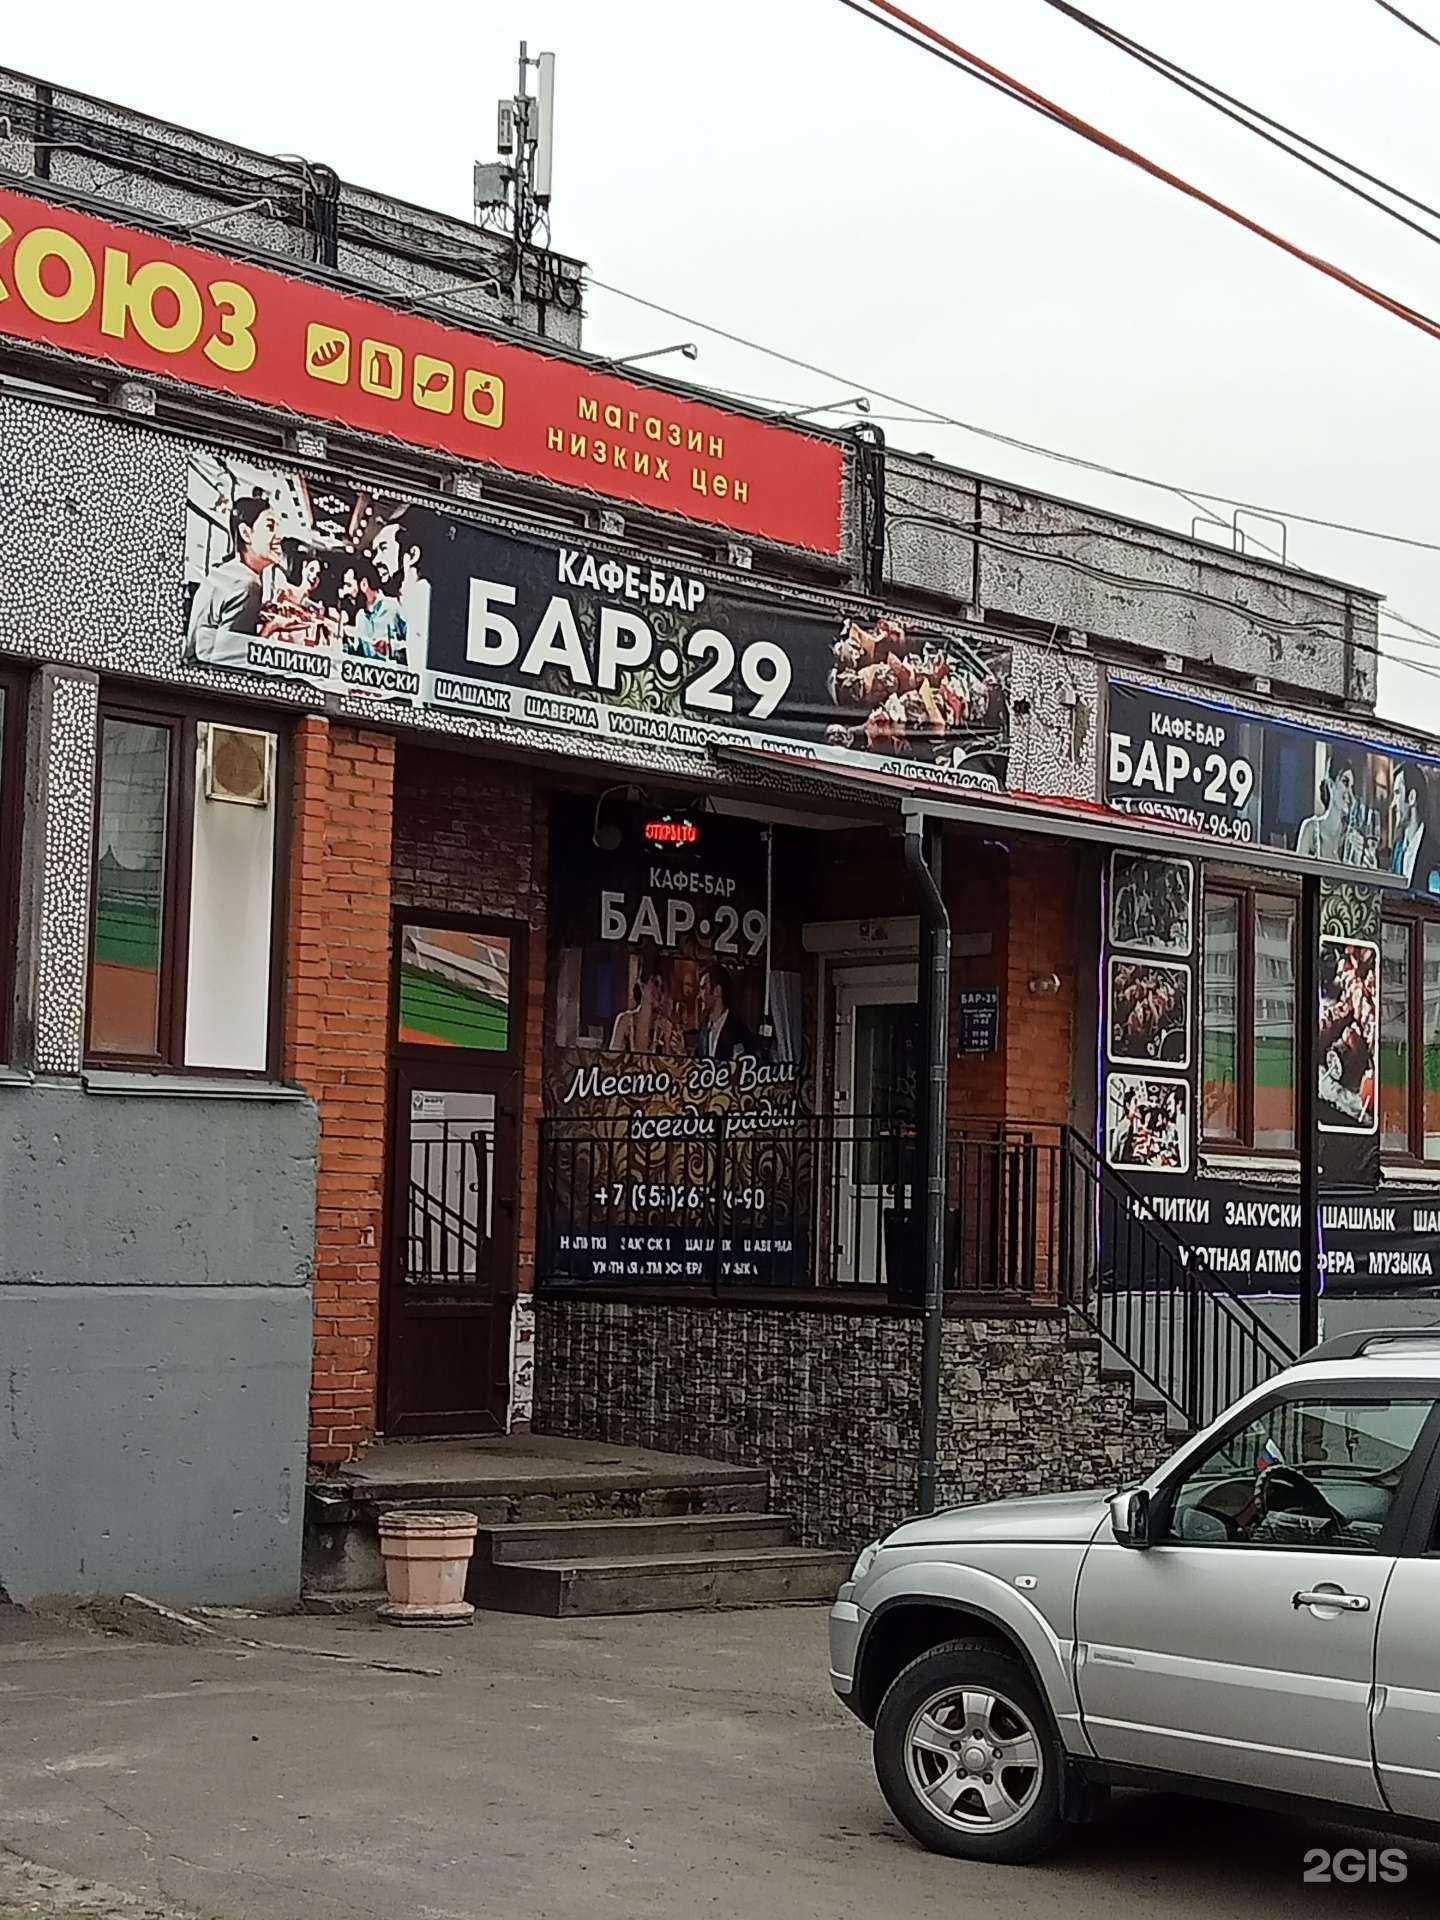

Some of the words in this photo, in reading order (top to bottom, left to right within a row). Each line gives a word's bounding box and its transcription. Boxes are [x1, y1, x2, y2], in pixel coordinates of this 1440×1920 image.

[0, 214, 256, 372] ОЮЗ
[578, 396, 724, 459] магазин
[547, 427, 671, 482] низких
[691, 467, 749, 503] цен
[557, 548, 707, 612] КАФЕ-БАР
[248, 643, 331, 678] НАПИТКИ
[341, 663, 419, 695] ЗАКУСКИ
[436, 680, 512, 711] ШАШЛЫК
[525, 697, 597, 728] ШАВЕРМА
[609, 713, 667, 740] УЮТНАЯ
[1151, 712, 1225, 748] КАФЕ-БАР
[645, 823, 696, 842] ОТКРЫТО
[650, 867, 736, 897] КАФЕ-БАР
[564, 1067, 679, 1103] Место,
[688, 1059, 730, 1090] где
[739, 1055, 796, 1092] Вам
[1225, 1201, 1301, 1228] ЗАКУСКИ
[1322, 1206, 1396, 1231] ШАШЛЫК
[1413, 1209, 1440, 1232] ША
[1368, 1251, 1433, 1276] МУЗЫКА
